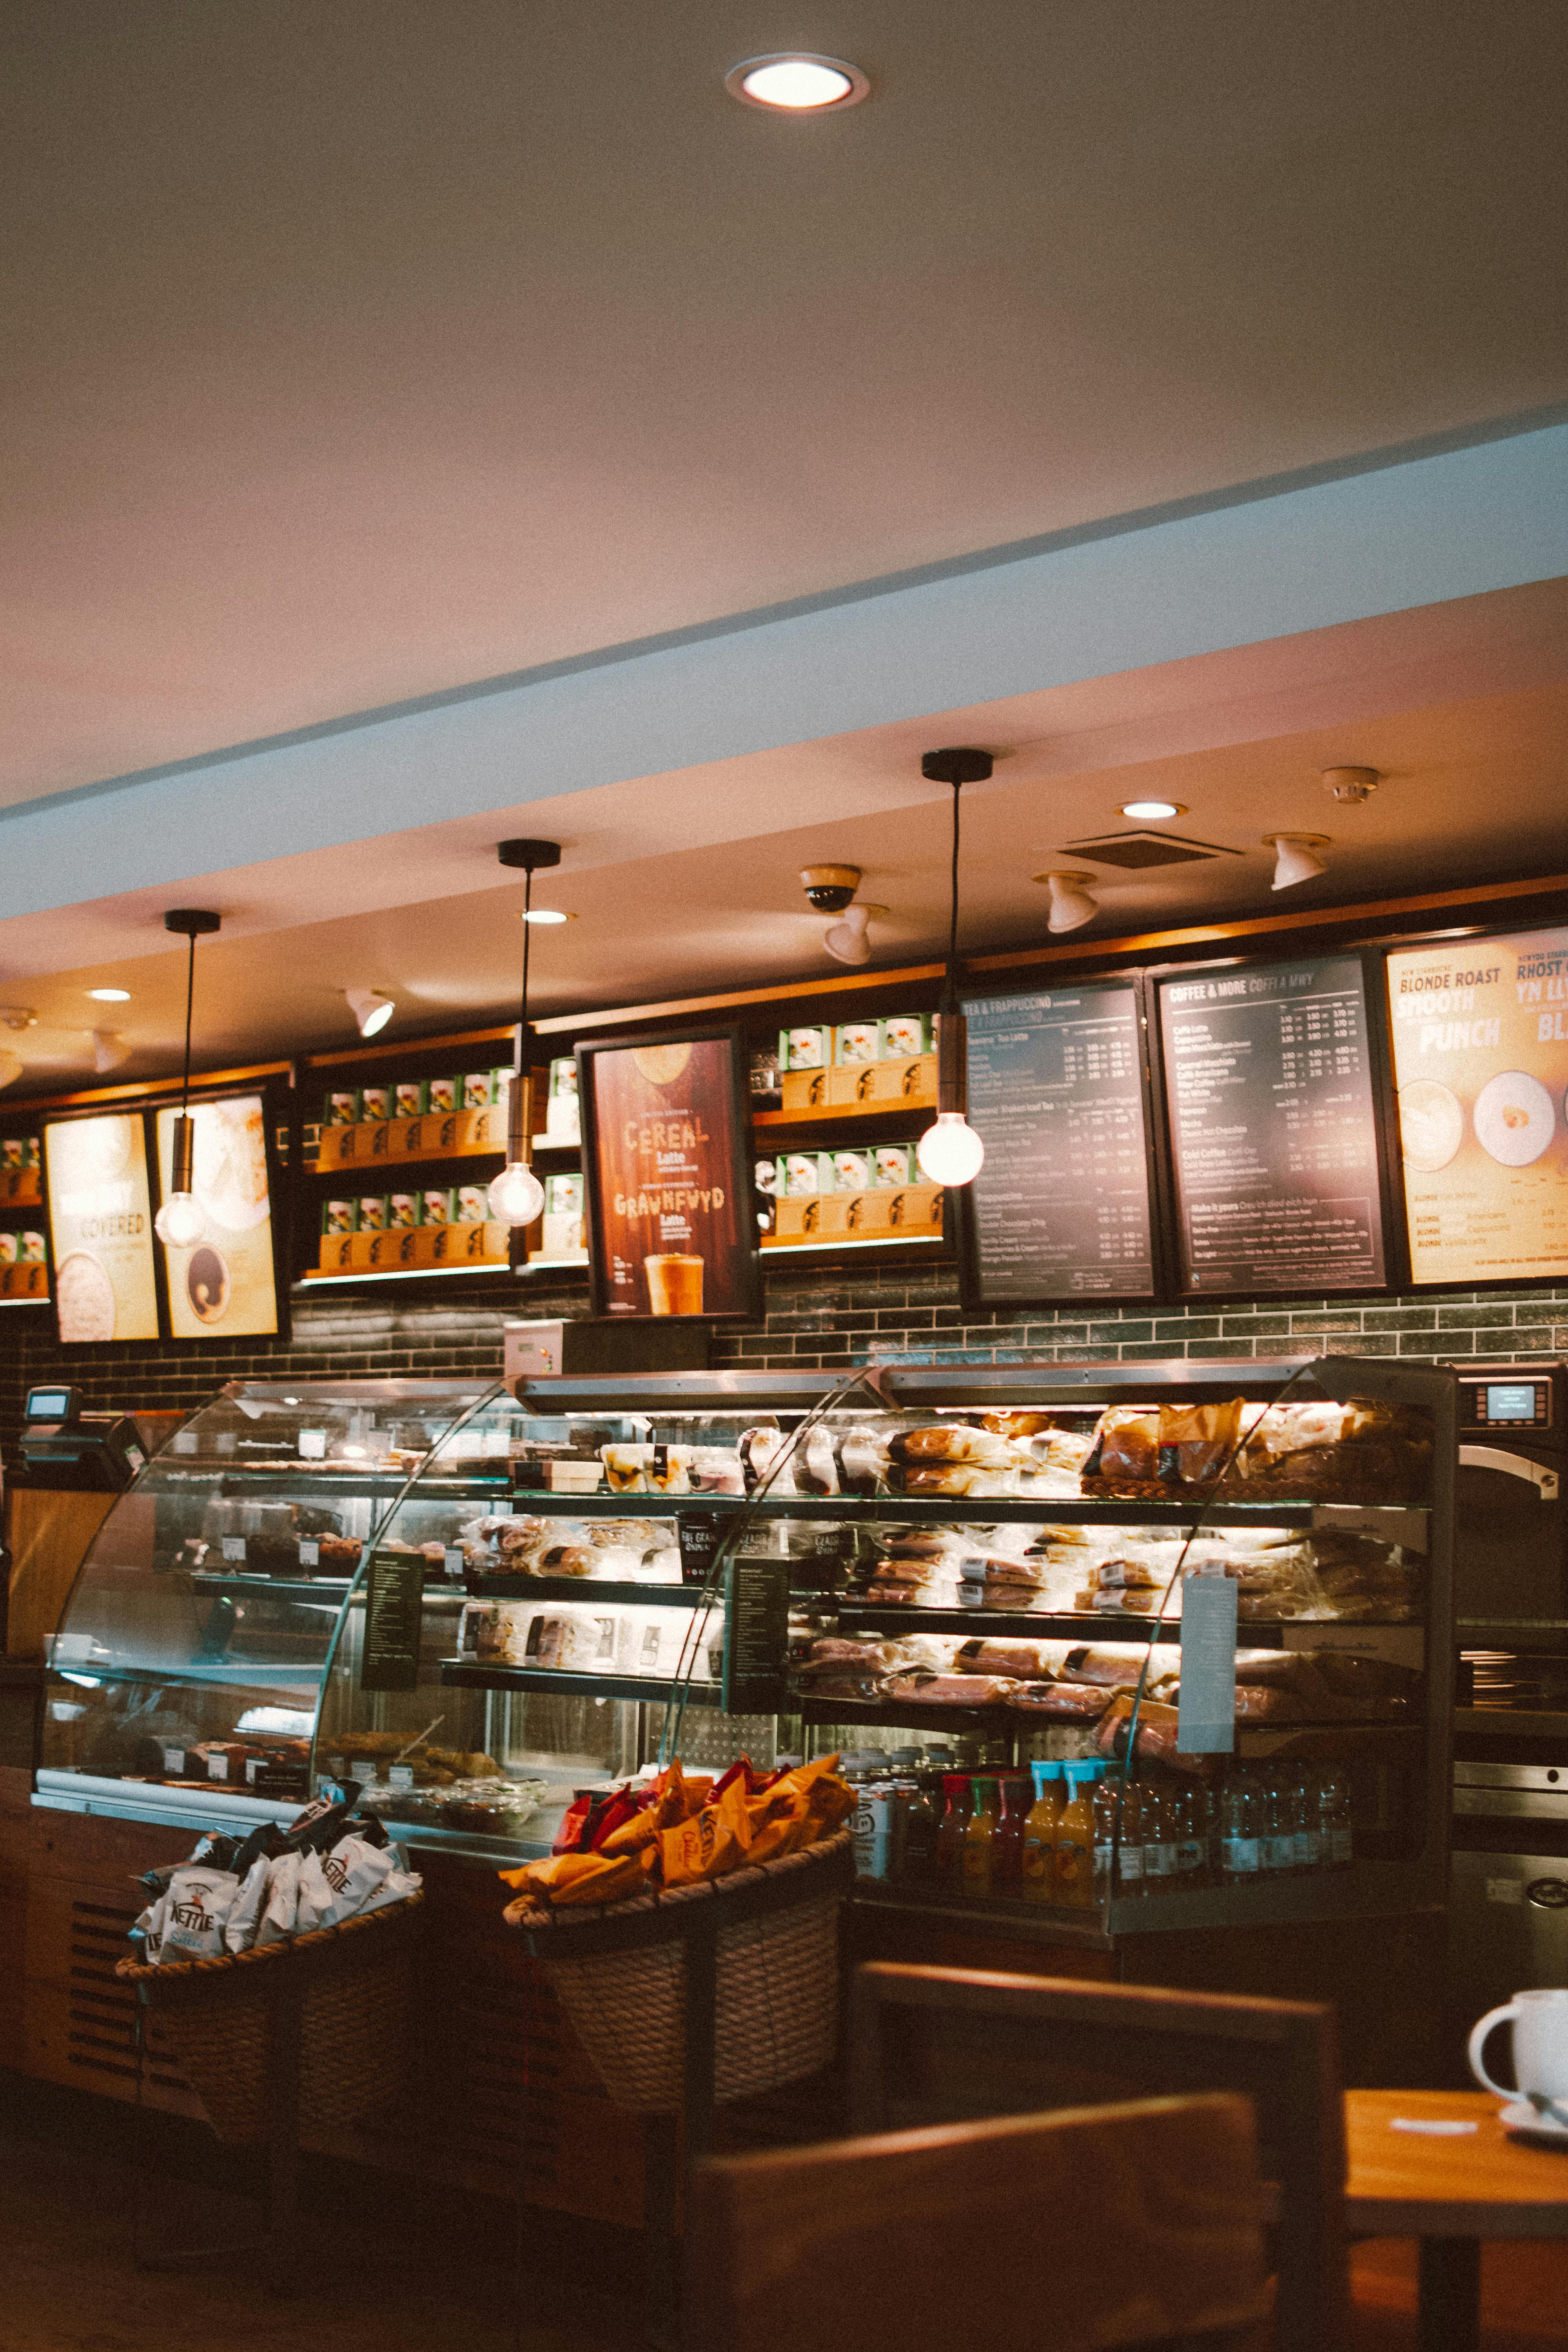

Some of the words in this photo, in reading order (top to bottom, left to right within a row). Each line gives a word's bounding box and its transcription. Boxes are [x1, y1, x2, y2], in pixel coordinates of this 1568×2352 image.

[1401, 974, 1450, 993] BLONDE
[1455, 967, 1501, 987] ROAST
[1517, 960, 1563, 980] RHOST
[1169, 984, 1207, 1002] COFFEE
[1207, 983, 1218, 998] &
[1218, 980, 1247, 996] MORE
[1397, 988, 1474, 1018] SMOOTH
[1515, 980, 1542, 1004] YN
[963, 1002, 980, 1016] TEA
[981, 1002, 989, 1015] &
[990, 995, 1052, 1013] FRAPPUCCINO
[1419, 1017, 1501, 1054] PUNCH
[623, 1117, 710, 1155] CEREAL
[657, 1151, 686, 1165] Latte
[614, 1187, 725, 1219] GRAWNFWYD
[81, 1213, 145, 1238] COVERED
[660, 1214, 686, 1227] Latte
[321, 1857, 352, 1895] KETTLE
[170, 1899, 214, 1933] KETTLE
